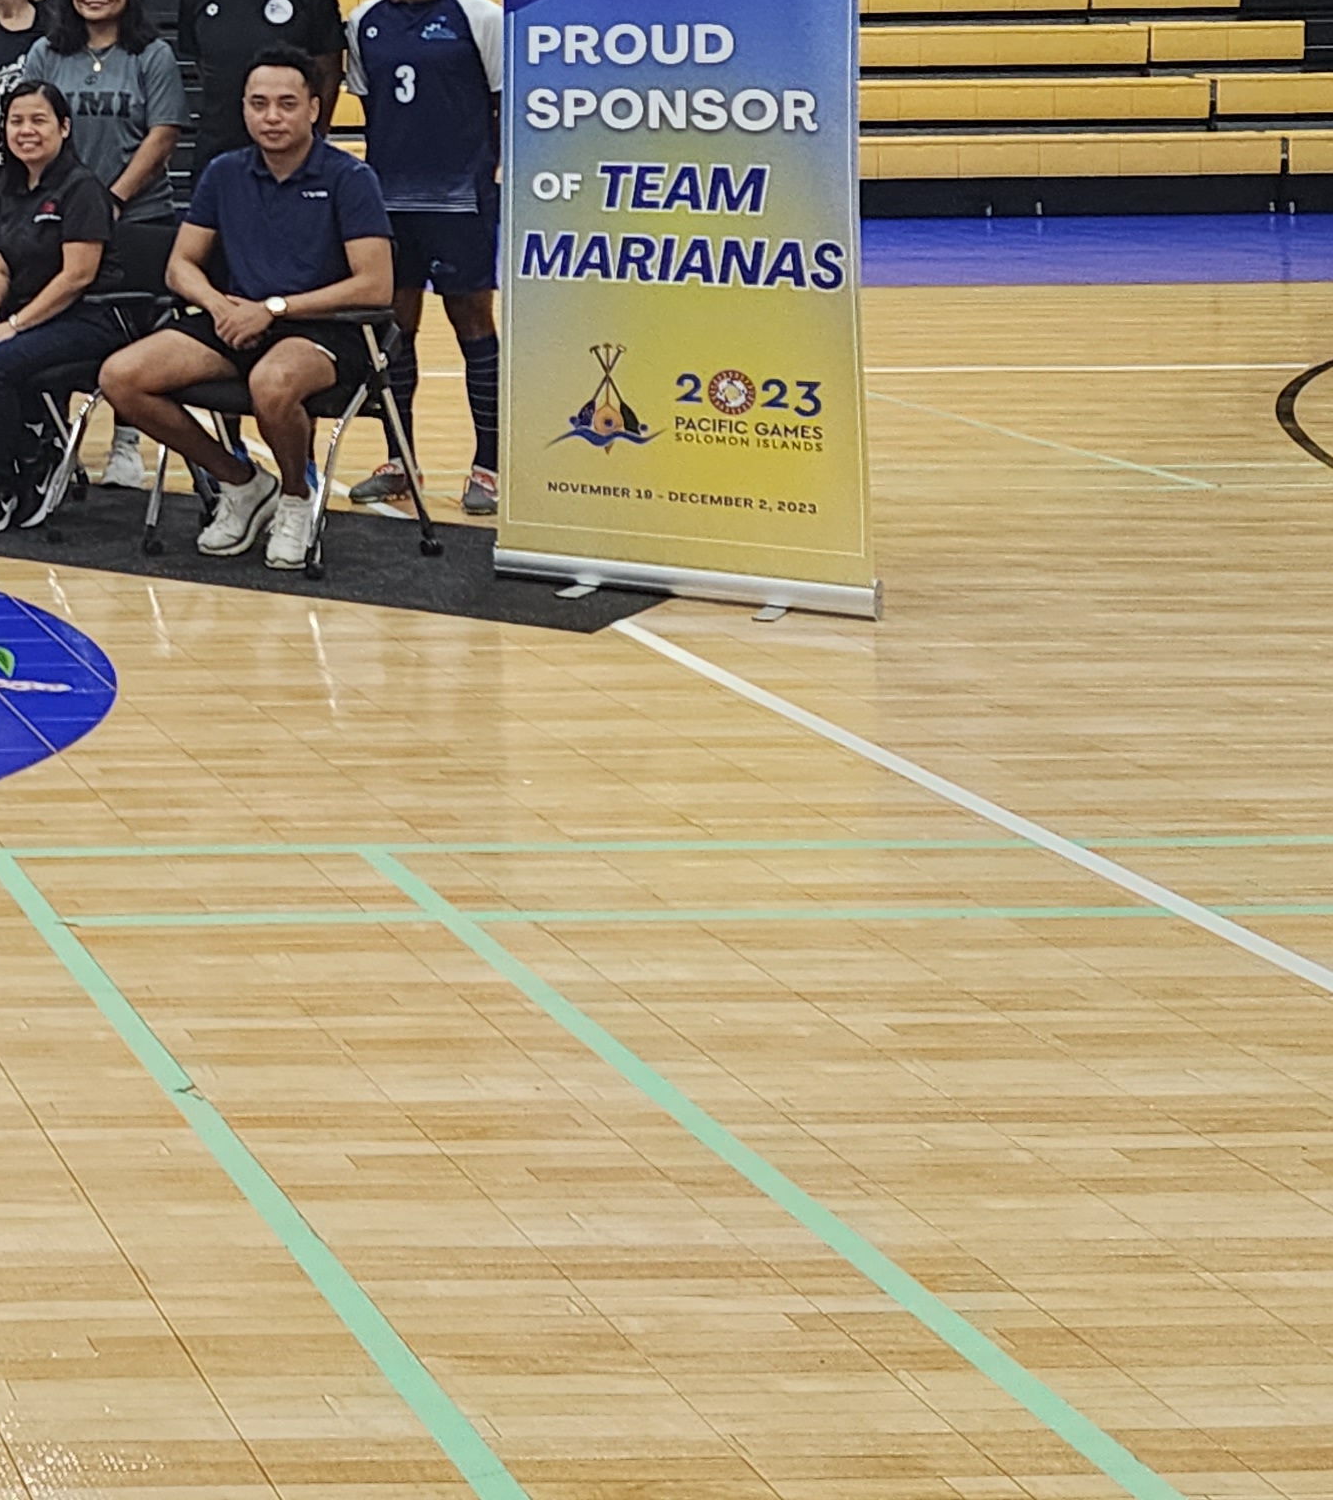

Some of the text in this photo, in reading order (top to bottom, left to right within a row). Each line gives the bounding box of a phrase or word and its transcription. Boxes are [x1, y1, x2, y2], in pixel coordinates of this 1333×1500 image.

[526, 22, 735, 66] PROUD
[394, 64, 416, 104] 3
[525, 87, 819, 133] SPONSOR
[532, 162, 771, 216] OF TEAM
[518, 230, 845, 294] MARIANAS
[675, 369, 822, 417] 2023
[675, 415, 823, 440] PACIFIC GAMES
[675, 432, 823, 453] SOLOMON ISLANDS
[547, 481, 631, 499] NOVEMBER
[667, 490, 754, 509] DECEMBER
[758, 499, 772, 513] 2,
[777, 500, 817, 515] 2023
